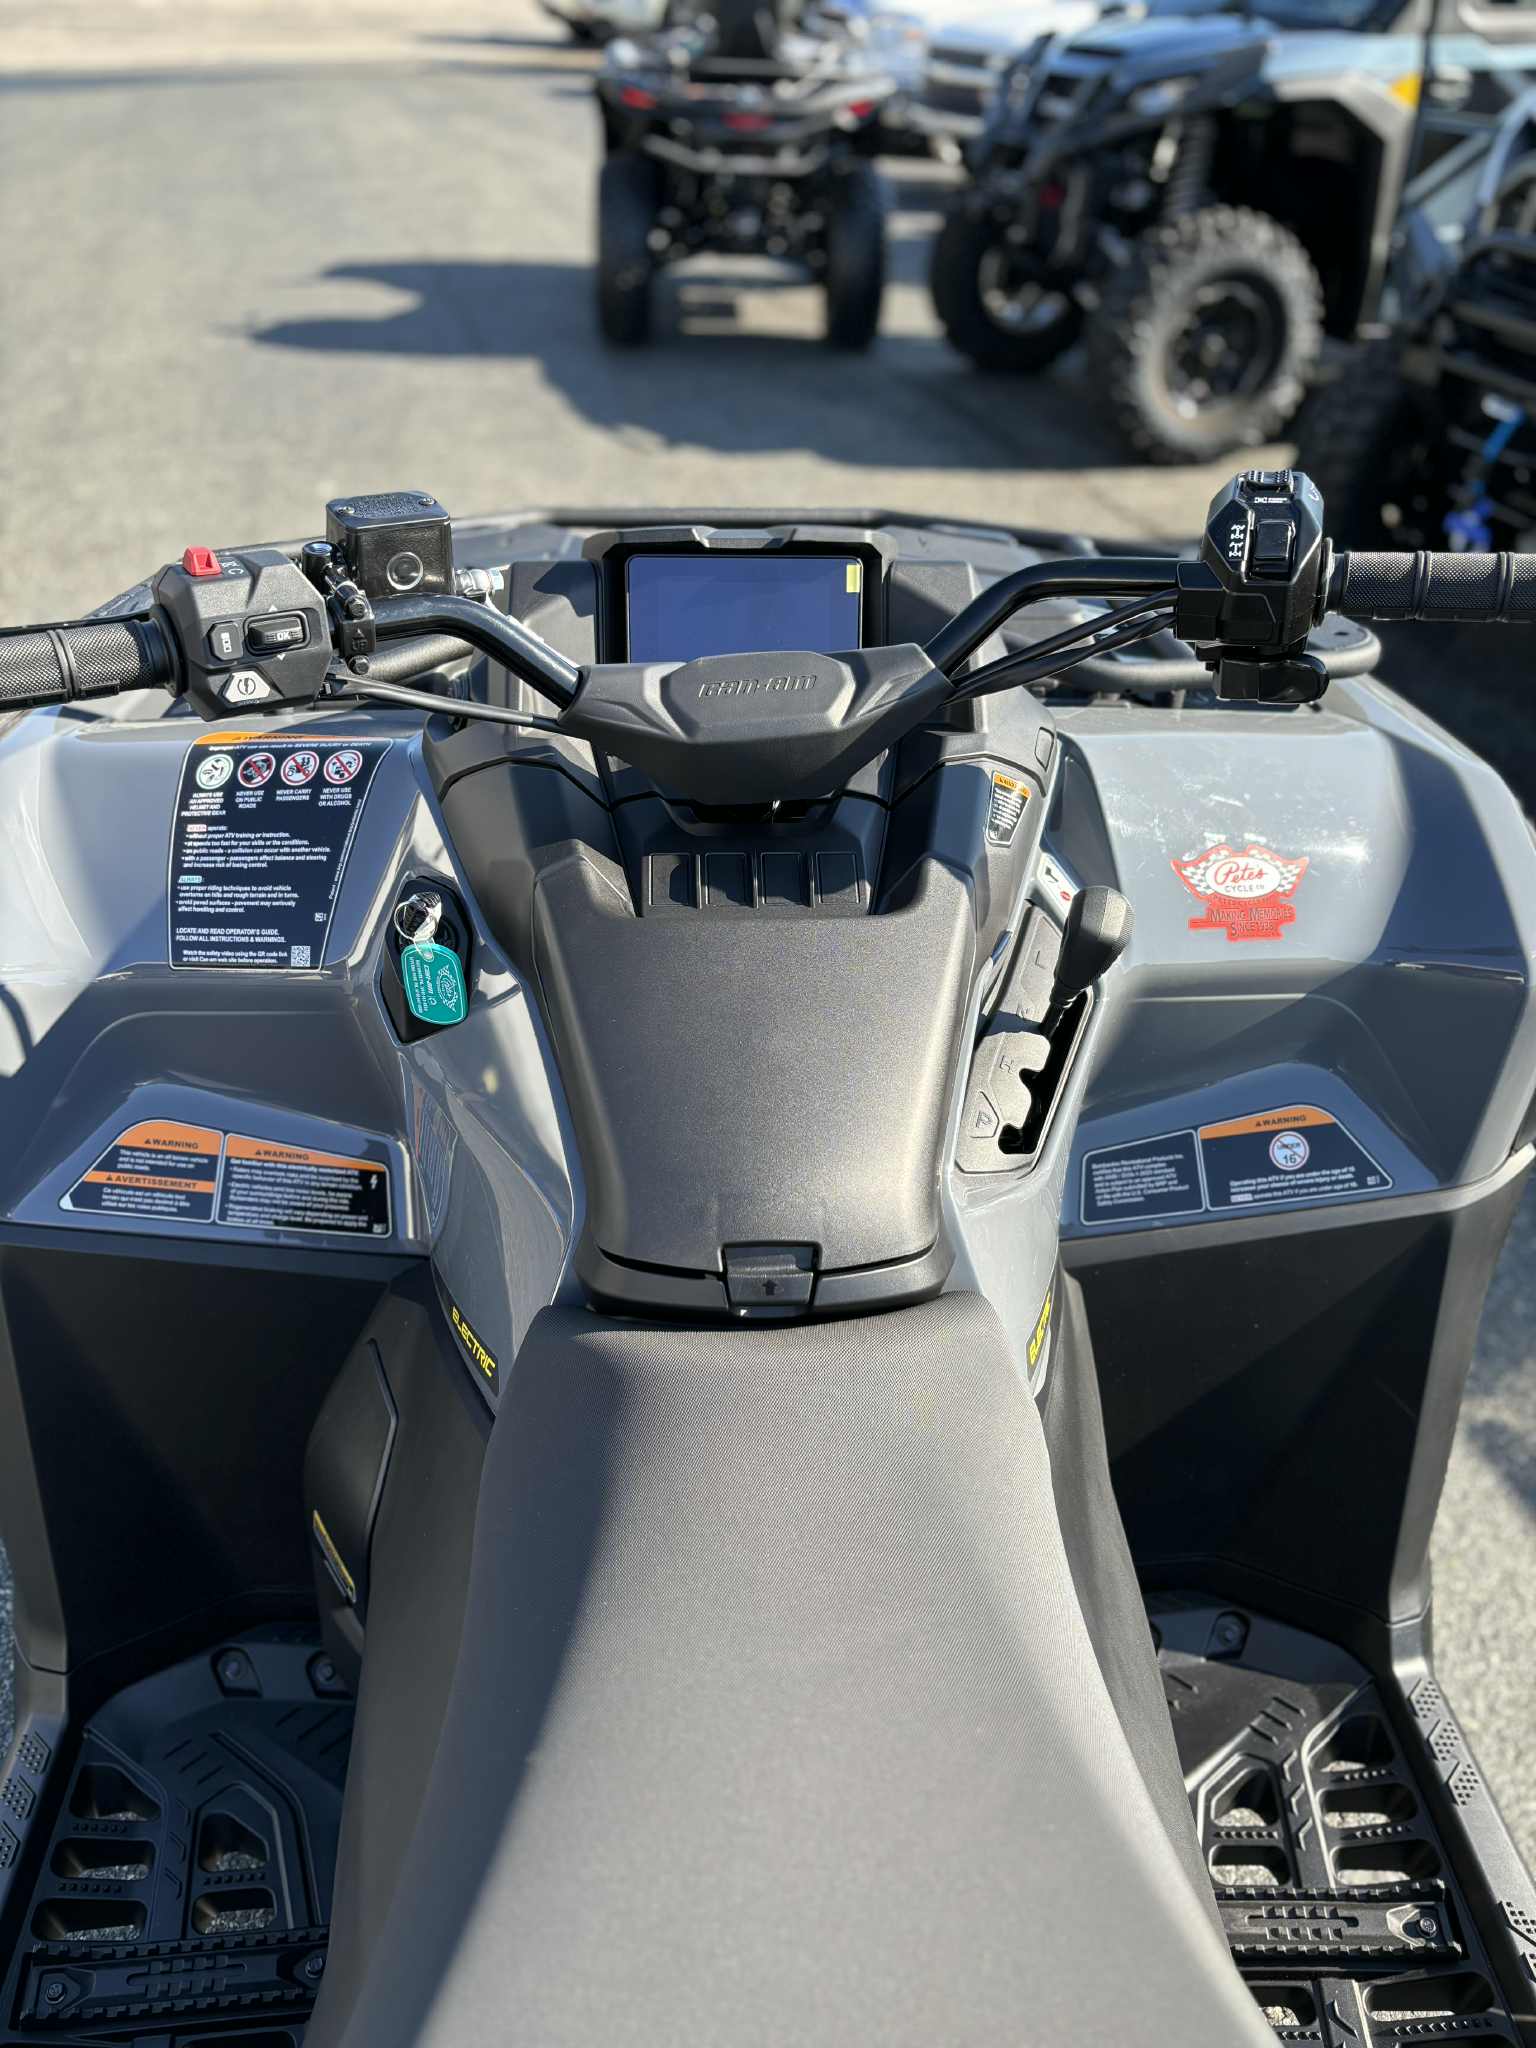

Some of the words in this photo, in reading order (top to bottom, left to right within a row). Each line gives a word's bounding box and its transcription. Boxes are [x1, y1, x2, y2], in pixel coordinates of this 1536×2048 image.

[277, 631, 290, 640] OK
[1262, 1115, 1306, 1126] WARNING
[153, 1139, 198, 1149] WARNING
[263, 1150, 309, 1160] WARNING
[1284, 1154, 1296, 1164] 16
[115, 1175, 198, 1189] AVERTISSEMENT
[452, 1305, 496, 1378] ELECTRIC
